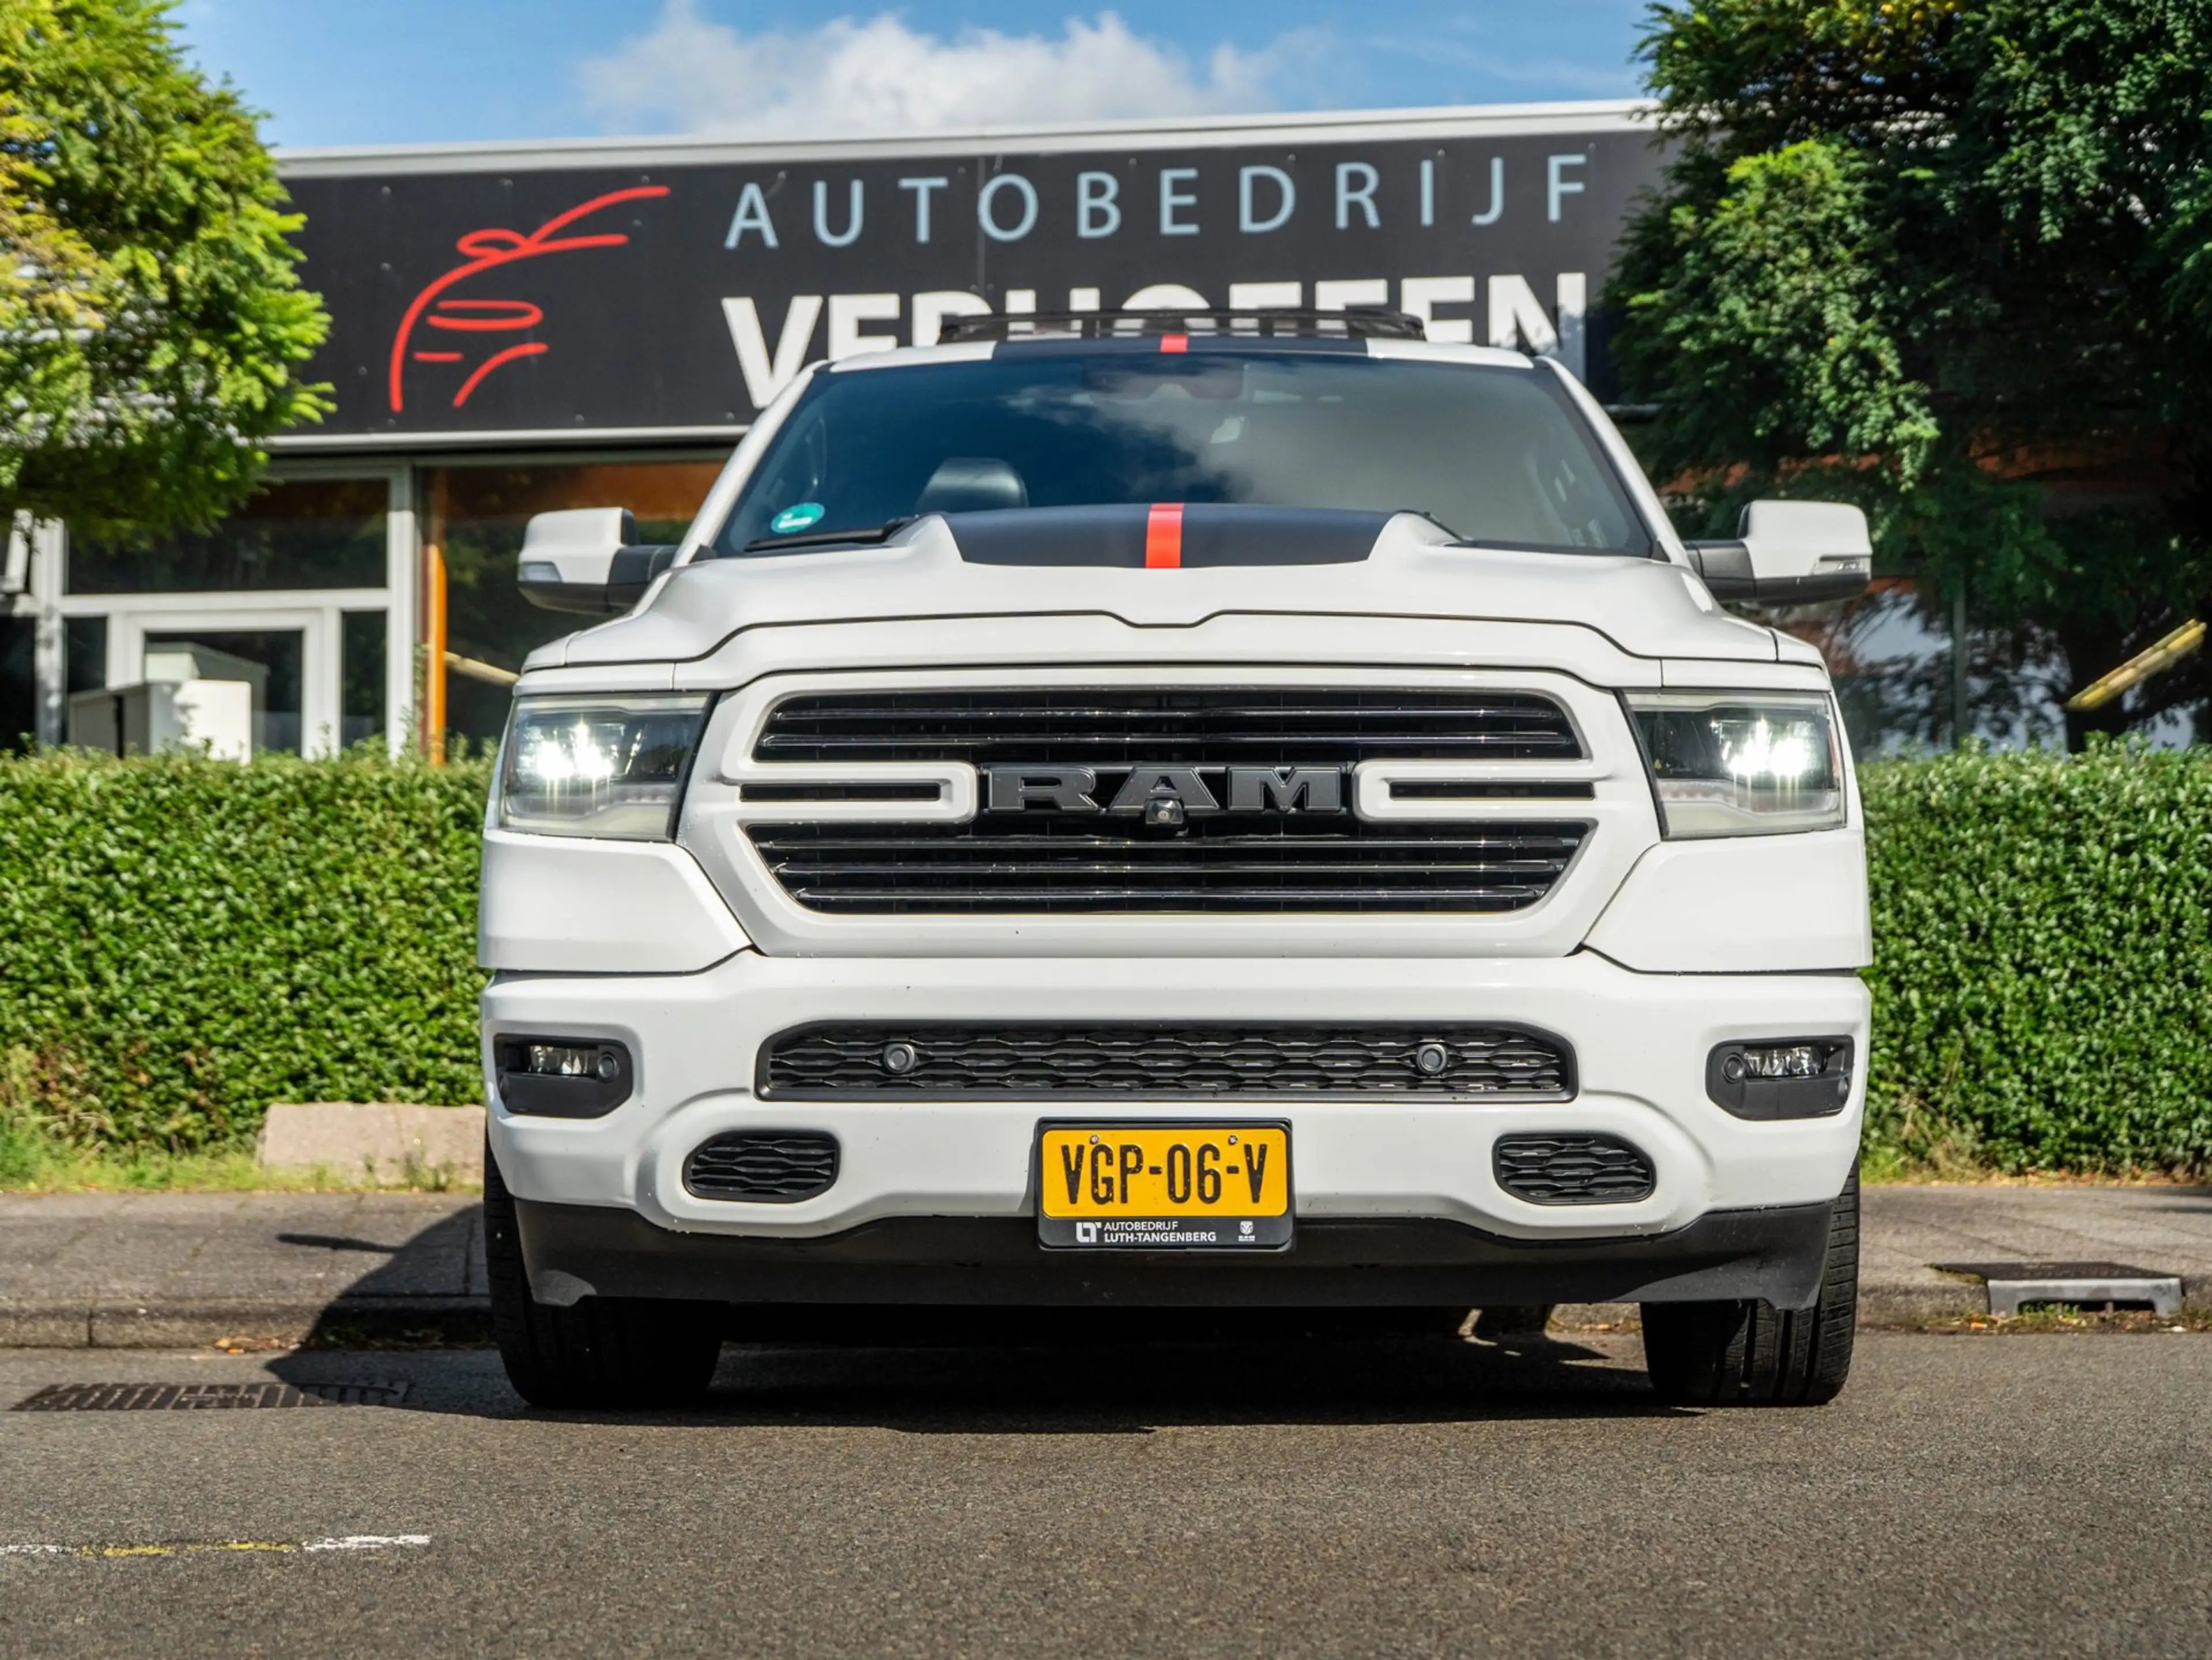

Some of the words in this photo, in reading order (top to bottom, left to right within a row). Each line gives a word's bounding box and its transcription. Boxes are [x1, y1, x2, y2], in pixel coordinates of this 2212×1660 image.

[724, 154, 1588, 248] AUTOBEDRIJF
[987, 767, 1342, 810] RAM
[1060, 1144, 1267, 1204] VGP-06-V
[1104, 1221, 1178, 1231] AUTOBEDRIJF
[1104, 1232, 1216, 1242] LUTH-TANGENBERG
